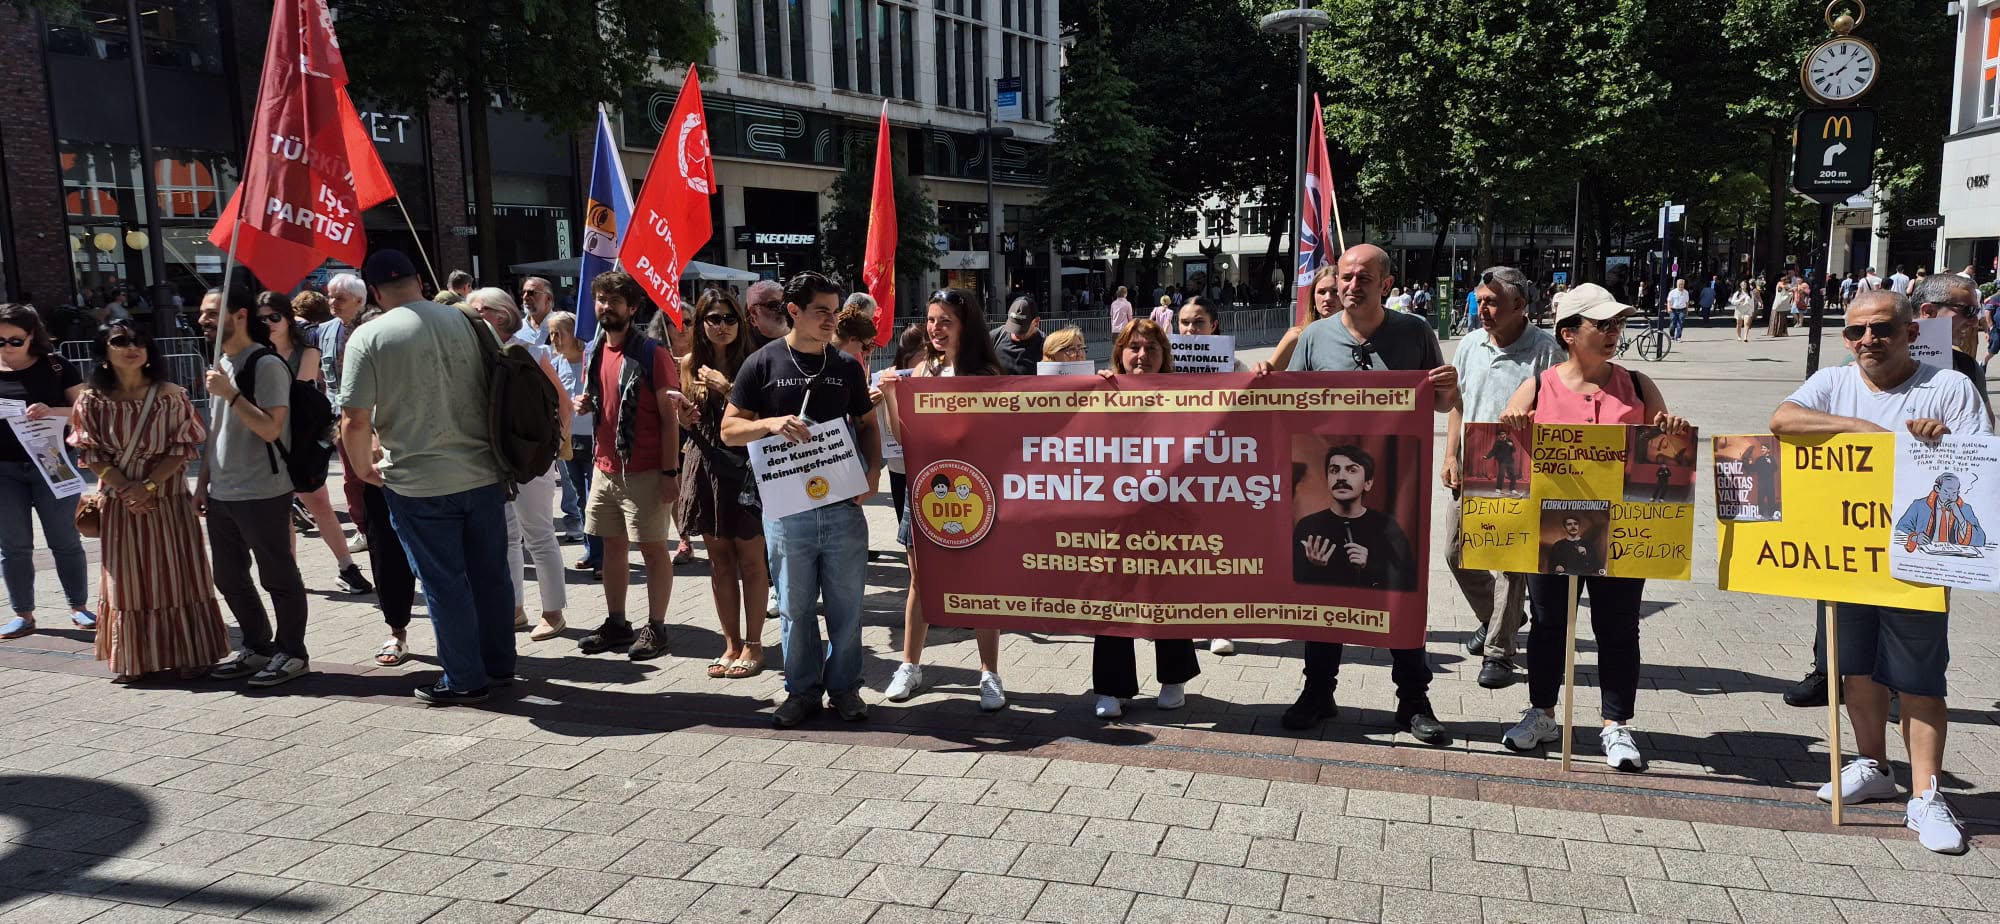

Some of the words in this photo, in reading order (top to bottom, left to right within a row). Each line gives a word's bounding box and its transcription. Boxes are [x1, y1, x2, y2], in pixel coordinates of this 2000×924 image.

[267, 197, 355, 245] PARTİSİ
[1906, 217, 1937, 226] CHRIST
[755, 233, 815, 244] SKECHERS
[1173, 355, 1229, 363] NATIONALE
[1176, 365, 1219, 373] DARITÄT!
[919, 394, 977, 411] Finger
[983, 395, 1020, 411] weg
[1026, 395, 1063, 408] von
[1066, 393, 1099, 408] der
[1104, 392, 1170, 407] Kunst-
[1176, 391, 1213, 406] und
[1219, 389, 1409, 409] Meinungsfreiheit!
[803, 433, 825, 445] eg
[825, 428, 841, 438] von
[1537, 425, 1584, 443] İFADE
[767, 456, 788, 467] der
[789, 447, 827, 461] Kunst-
[828, 438, 844, 450] und
[1022, 437, 1175, 463] FREIHEIT
[1184, 430, 1258, 463] FÜR
[761, 449, 854, 482] Meinungsfreiheit!
[1716, 460, 1744, 474] DENİZ
[1796, 444, 1873, 472] DENİZ
[1003, 469, 1104, 501] DENİZ
[1113, 469, 1280, 510] GÖKTAŞ!
[1718, 474, 1753, 491] GÖKTAŞ
[1718, 490, 1749, 502] YALNIZ
[932, 503, 972, 517] DIDF
[1542, 501, 1608, 510] KORKUYORSUNUZ!
[1611, 503, 1687, 520] DÜŞÜNCE
[1056, 529, 1120, 550] DENİZ
[1125, 531, 1224, 555] GÖKTAŞ
[1461, 532, 1531, 550] ADALET
[1612, 528, 1652, 539] SUÇ
[1022, 553, 1116, 573] SERBEST
[1122, 558, 1264, 575] BIRAKILSIN!
[1757, 540, 1885, 572] ADALET
[949, 595, 1000, 610] Sanat
[1005, 600, 1027, 612] ve
[1031, 598, 1076, 614] ifade
[1081, 601, 1228, 623] özgürlüğünden
[1233, 604, 1318, 621] ellerinizi
[1323, 608, 1384, 628] çekin!
